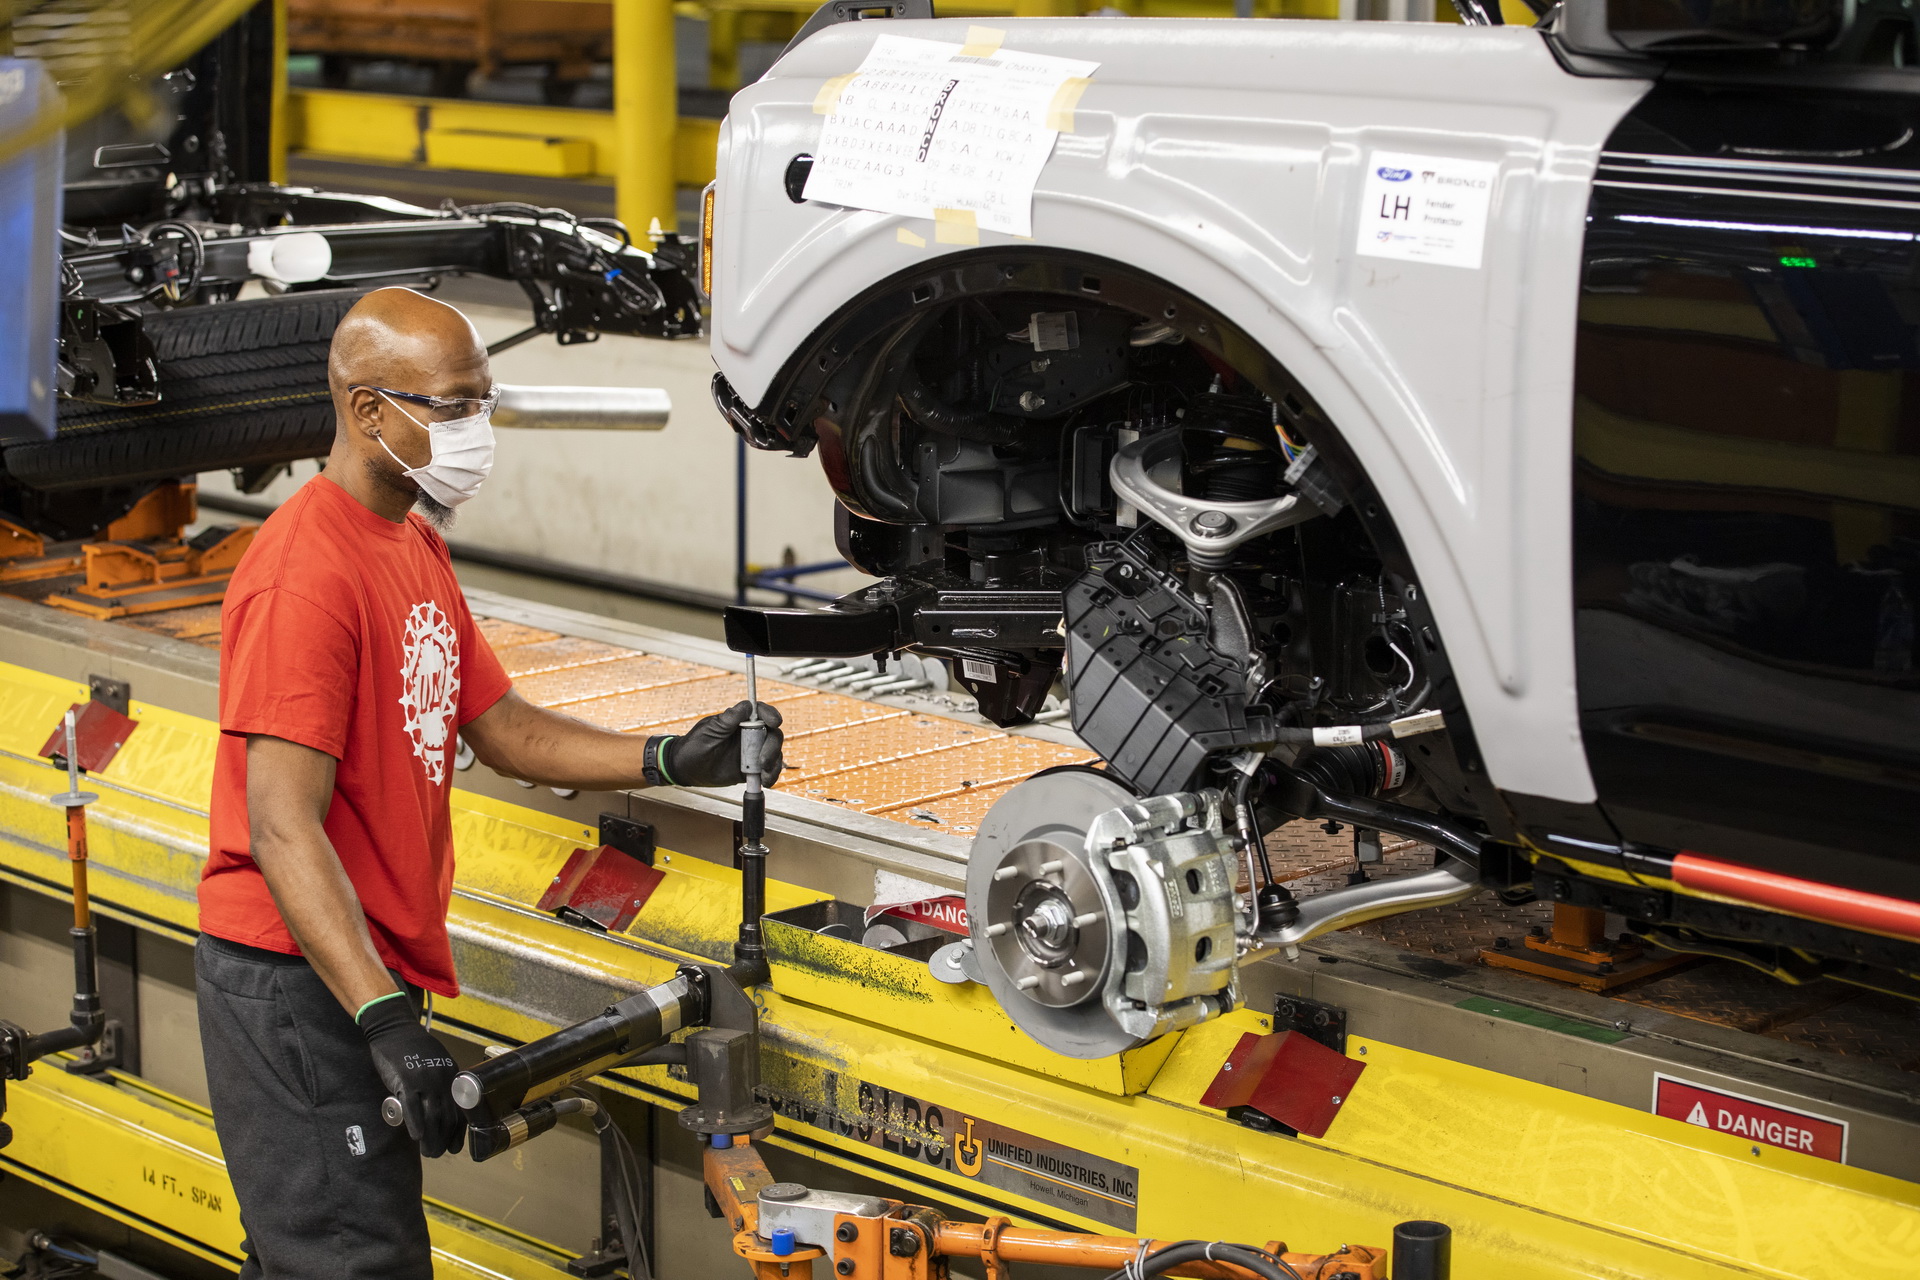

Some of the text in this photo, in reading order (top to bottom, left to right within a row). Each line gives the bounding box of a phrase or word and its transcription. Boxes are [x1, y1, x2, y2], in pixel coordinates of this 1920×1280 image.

[917, 80, 957, 162] BRONCO
[1437, 176, 1487, 189] BRONCO
[1380, 193, 1455, 221] LH Fender
[1423, 213, 1464, 227] Protector
[1717, 1109, 1814, 1152] DANGER
[988, 1138, 1137, 1199] UNIFIED INDUSTRIES, INC.
[163, 1174, 183, 1198] FT.
[191, 1186, 222, 1213] SPAN
[1057, 1188, 1089, 1207] Michigan
